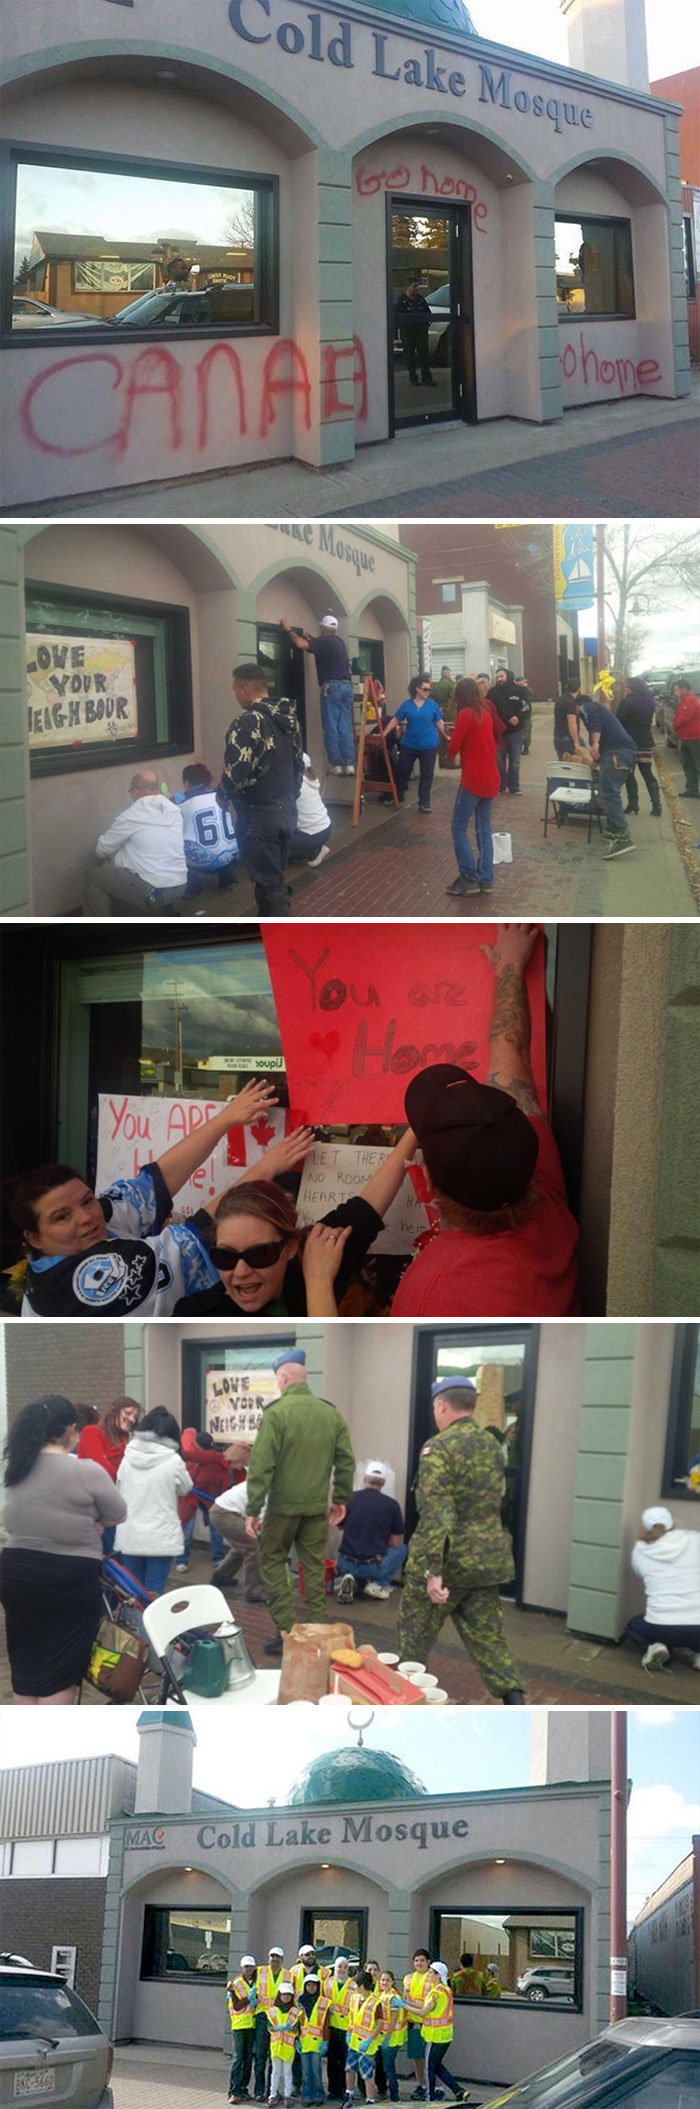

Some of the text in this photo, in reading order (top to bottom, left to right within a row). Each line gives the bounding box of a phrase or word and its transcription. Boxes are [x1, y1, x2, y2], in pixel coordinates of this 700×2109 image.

[228, 0, 594, 133] Cold Lake Mosque
[355, 164, 488, 234] Go home
[580, 332, 662, 392] home
[264, 524, 376, 576] ake Mosque
[49, 673, 107, 697] YOUR
[289, 946, 470, 1013] You are
[352, 1017, 480, 1081] Home
[109, 1097, 152, 1141] You
[307, 1171, 373, 1185] NO ROOM
[311, 1150, 391, 1165] LET THER
[212, 1376, 249, 1397] LOVE
[229, 1396, 264, 1410] YOUR
[126, 1816, 469, 1849] MAC Cold Lake Mosque
